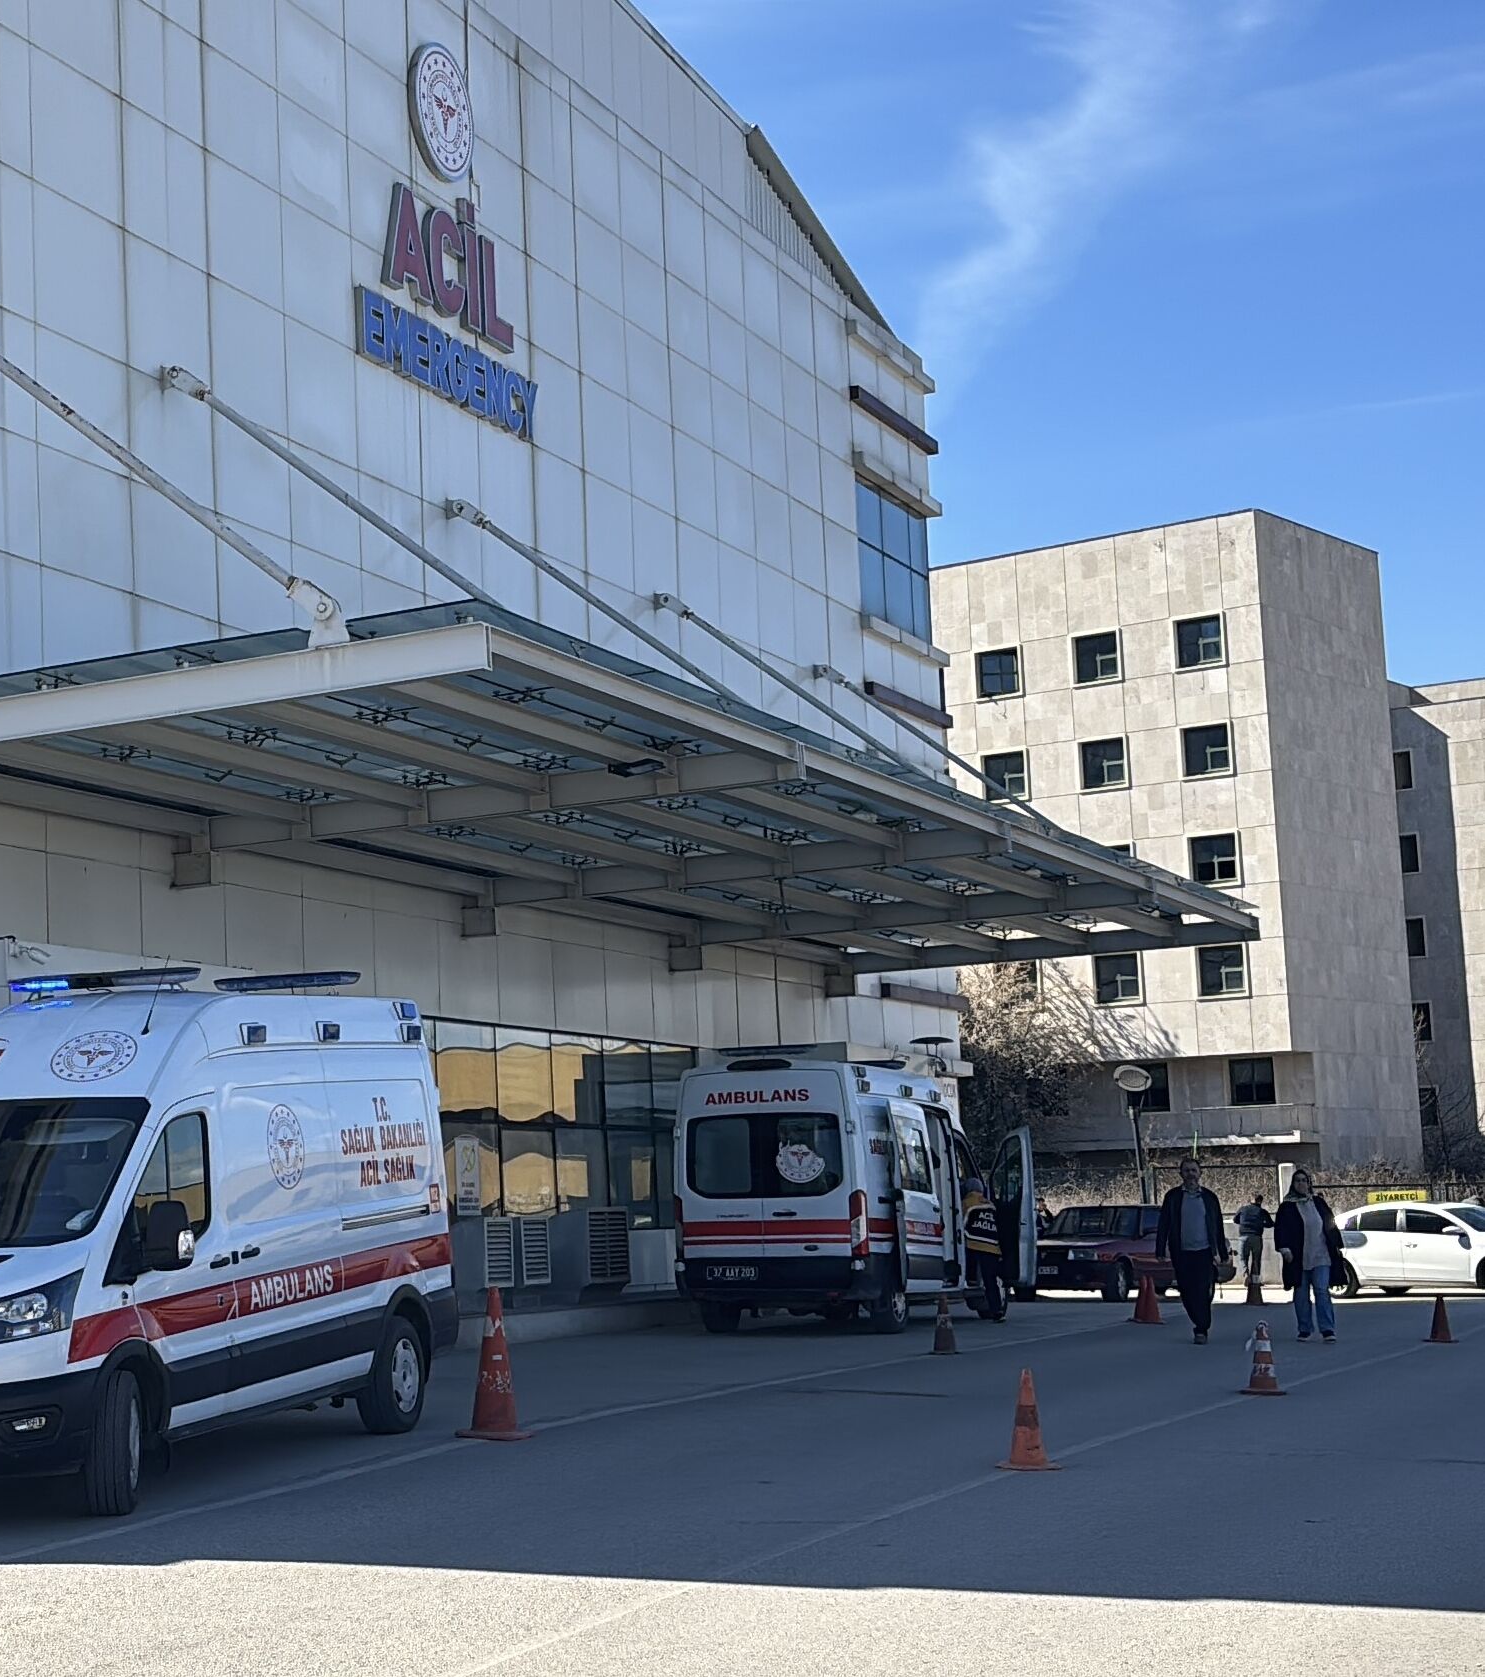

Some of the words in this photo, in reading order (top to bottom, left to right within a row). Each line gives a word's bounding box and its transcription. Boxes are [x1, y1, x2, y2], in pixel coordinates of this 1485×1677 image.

[382, 183, 514, 352] ACİL
[355, 287, 538, 440] EMERGENCY
[372, 1096, 391, 1123] T.C.
[705, 1088, 809, 1105] AMBULANS
[340, 1124, 376, 1156] SAĞLIK
[379, 1118, 426, 1150] BAKANLIĞI
[360, 1156, 381, 1187] ACİL
[384, 1152, 415, 1183] SAĞLIK
[250, 1264, 334, 1311] AMBULANS
